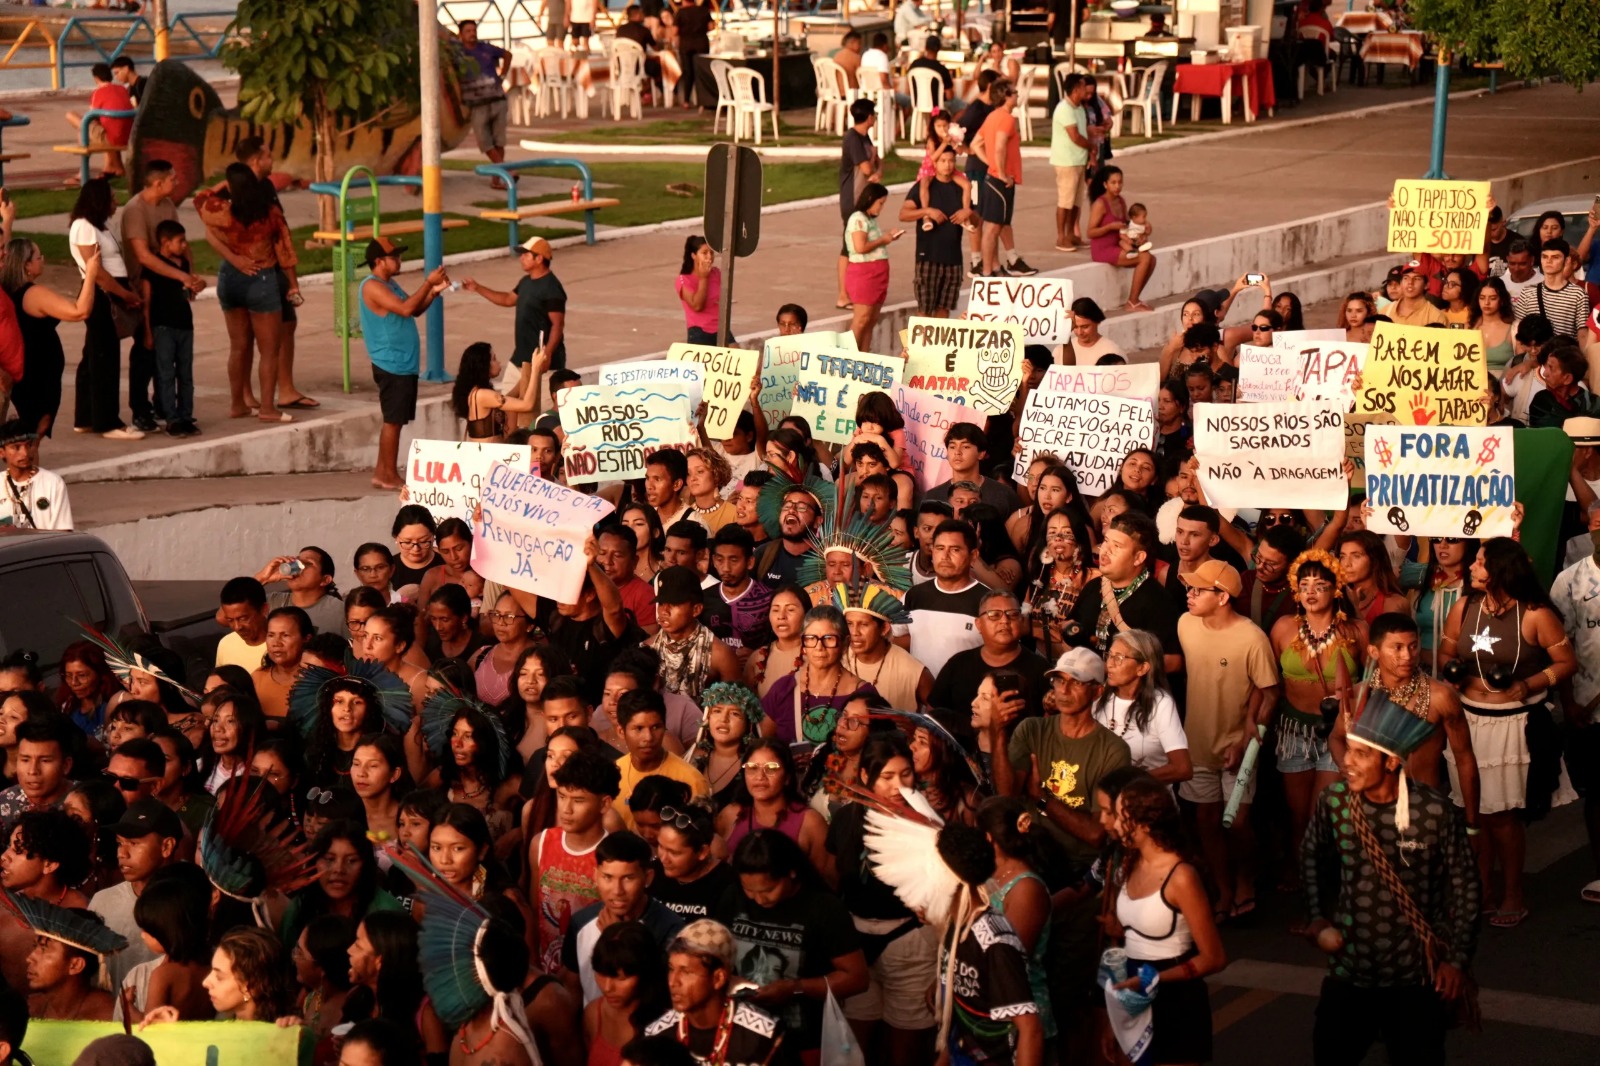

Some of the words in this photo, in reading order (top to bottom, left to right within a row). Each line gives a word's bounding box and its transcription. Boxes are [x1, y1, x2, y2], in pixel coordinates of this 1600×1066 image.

[1398, 186, 1409, 207] O
[1429, 211, 1481, 229] ESTRADA
[1392, 230, 1417, 248] PRA
[1427, 230, 1473, 250] SOJA
[971, 280, 1065, 308] REVOGA
[911, 324, 1013, 349] PRIVATIZAR
[1373, 333, 1440, 364] PAREM
[1453, 342, 1480, 362] DE
[945, 349, 958, 372] É
[605, 373, 618, 386] SE
[620, 367, 679, 384] DESTRUIREM
[682, 369, 699, 381] OS
[909, 375, 970, 392] MATAR
[1387, 364, 1423, 390] NOS
[1424, 365, 1480, 392] MATAR
[796, 381, 828, 406] NÃO
[836, 384, 849, 408] É
[576, 404, 649, 425] NOSSOS
[815, 409, 827, 431] É
[1032, 393, 1111, 415] LUTAMOS
[1119, 404, 1154, 425] PELA
[601, 421, 644, 441] RIOS
[1057, 415, 1133, 436] REVOGAR
[1138, 425, 1150, 440] O
[1207, 415, 1270, 433] NOSSOS
[1273, 412, 1310, 430] RIOS
[1313, 409, 1342, 430] SÃO
[1021, 426, 1100, 449] DECRETO
[1229, 434, 1311, 449] SAGRADOS
[1400, 433, 1470, 459] FORA
[565, 445, 598, 477] NÃO
[597, 442, 645, 472] ESTÃO
[1208, 463, 1242, 480] NÃO
[1268, 462, 1344, 480] DRAGAGEM!
[490, 464, 572, 502] QUEREMOS
[1367, 468, 1514, 510] PRIVATIZAÇÃO
[482, 486, 522, 512] PAJÓS
[761, 929, 803, 944] NEWS
